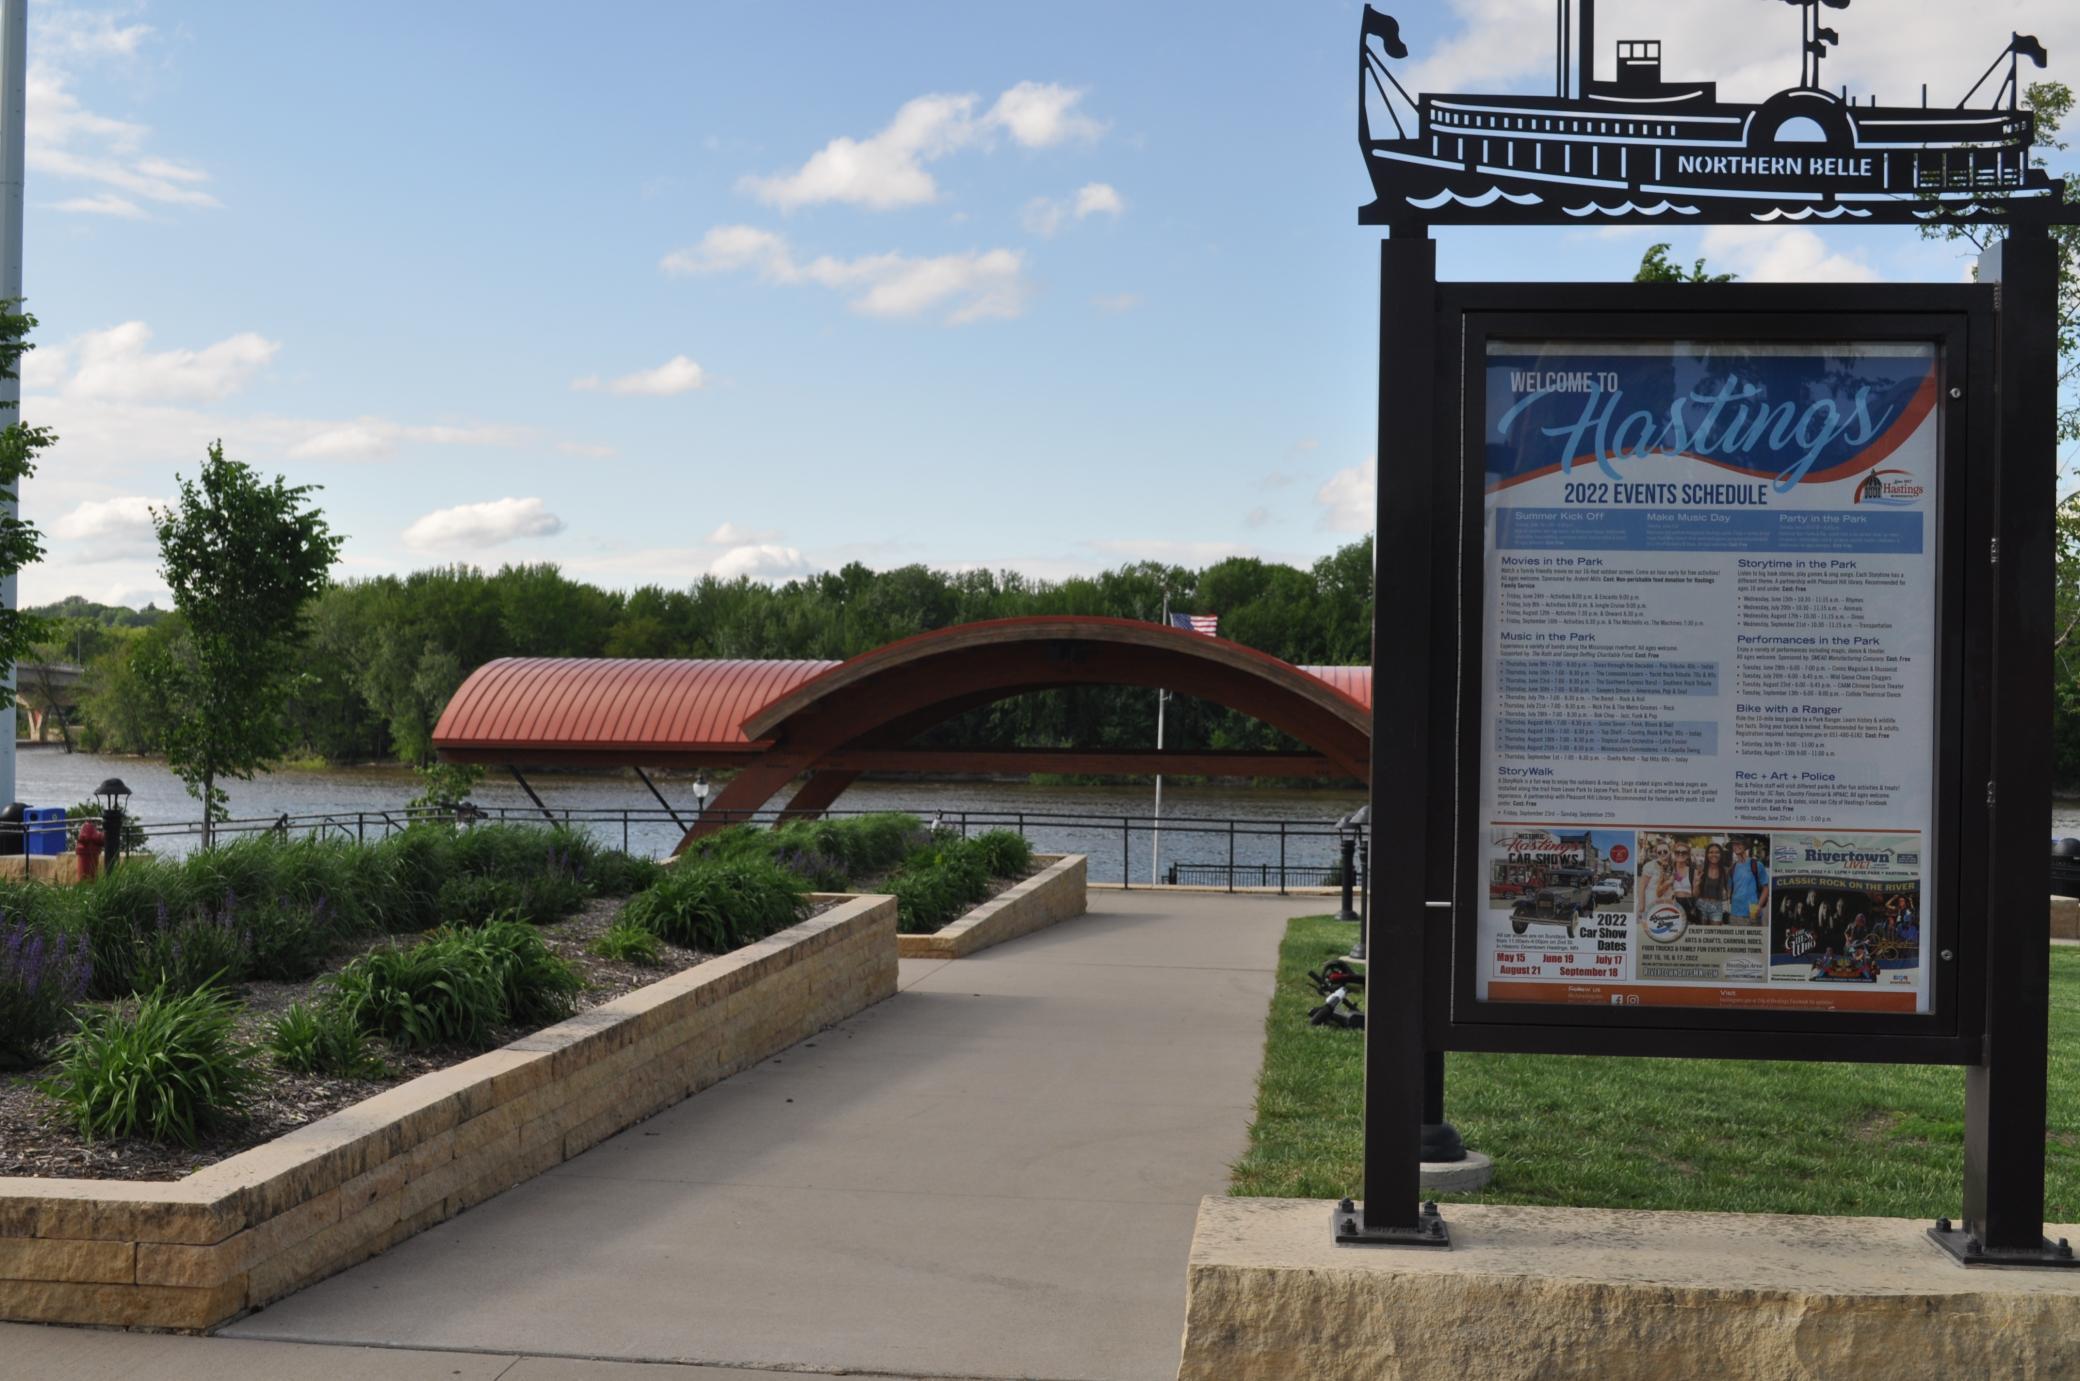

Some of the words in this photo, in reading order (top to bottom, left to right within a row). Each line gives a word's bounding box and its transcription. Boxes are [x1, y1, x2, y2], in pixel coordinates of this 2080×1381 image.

[1678, 156, 1802, 175] NORTHERN
[1809, 158, 1872, 176] BELLE
[1510, 371, 1593, 393] WELCOME
[1597, 371, 1618, 393] TO
[1497, 373, 1893, 494] Hastings
[1564, 483, 1608, 503] 2022
[1614, 483, 1677, 504] EVENTS
[1682, 484, 1768, 505] SCHEDULE
[1883, 483, 1923, 496] Hastings
[1515, 511, 1557, 520] Summer
[1560, 512, 1583, 520] Kick
[1586, 512, 1604, 520] Off
[1647, 513, 1674, 521] Make
[1677, 513, 1708, 522] Music
[1710, 514, 1731, 523] Day
[1779, 514, 1808, 524] Party
[1811, 514, 1820, 522] in
[1823, 514, 1839, 523] the
[1842, 515, 1867, 523] Park
[1501, 557, 1540, 566] Movies
[1543, 557, 1553, 566] in
[1556, 558, 1574, 566] the
[1577, 558, 1603, 567] Park
[1738, 559, 1793, 569] Storytime
[1796, 560, 1806, 568] in
[1809, 560, 1827, 568] the
[1830, 560, 1857, 569] Park
[1500, 632, 1532, 641] Music
[1536, 632, 1545, 641] in
[1549, 633, 1566, 641] the
[1570, 633, 1596, 641] Park
[1737, 635, 1816, 645] Performances
[1819, 636, 1829, 644] in
[1832, 637, 1850, 645] the
[1854, 637, 1880, 645] Park
[1736, 704, 1761, 713] Bike
[1765, 704, 1788, 713] with
[1802, 705, 1842, 715] Ranger
[1498, 766, 1554, 776] StoryWalk
[1735, 771, 1758, 780] Rec
[1770, 771, 1788, 780] Art
[1801, 772, 1836, 781] Police
[1508, 853, 1531, 865] CAR
[1536, 853, 1579, 866] SHOWS
[1805, 848, 1889, 863] Rivertown
[1843, 860, 1871, 870] LIVE!
[1776, 877, 1817, 886] CLASSIC
[1819, 878, 1846, 888] ROCK
[1849, 881, 1863, 890] ON
[1865, 883, 1884, 891] THE
[1887, 882, 1915, 891] RIVER
[1597, 914, 1627, 926] 2022
[1580, 927, 1598, 938] Car
[1599, 927, 1627, 939] Show
[1597, 940, 1627, 951] Dates
[1496, 953, 1515, 963] May
[1516, 953, 1526, 962] 15
[1542, 954, 1562, 963] June
[1564, 954, 1574, 963] 19
[1596, 955, 1612, 965] July
[1614, 955, 1623, 964] 17
[1500, 965, 1530, 975] August
[1531, 966, 1541, 975] 21
[1559, 966, 1607, 977] September
[1608, 967, 1618, 977] 18
